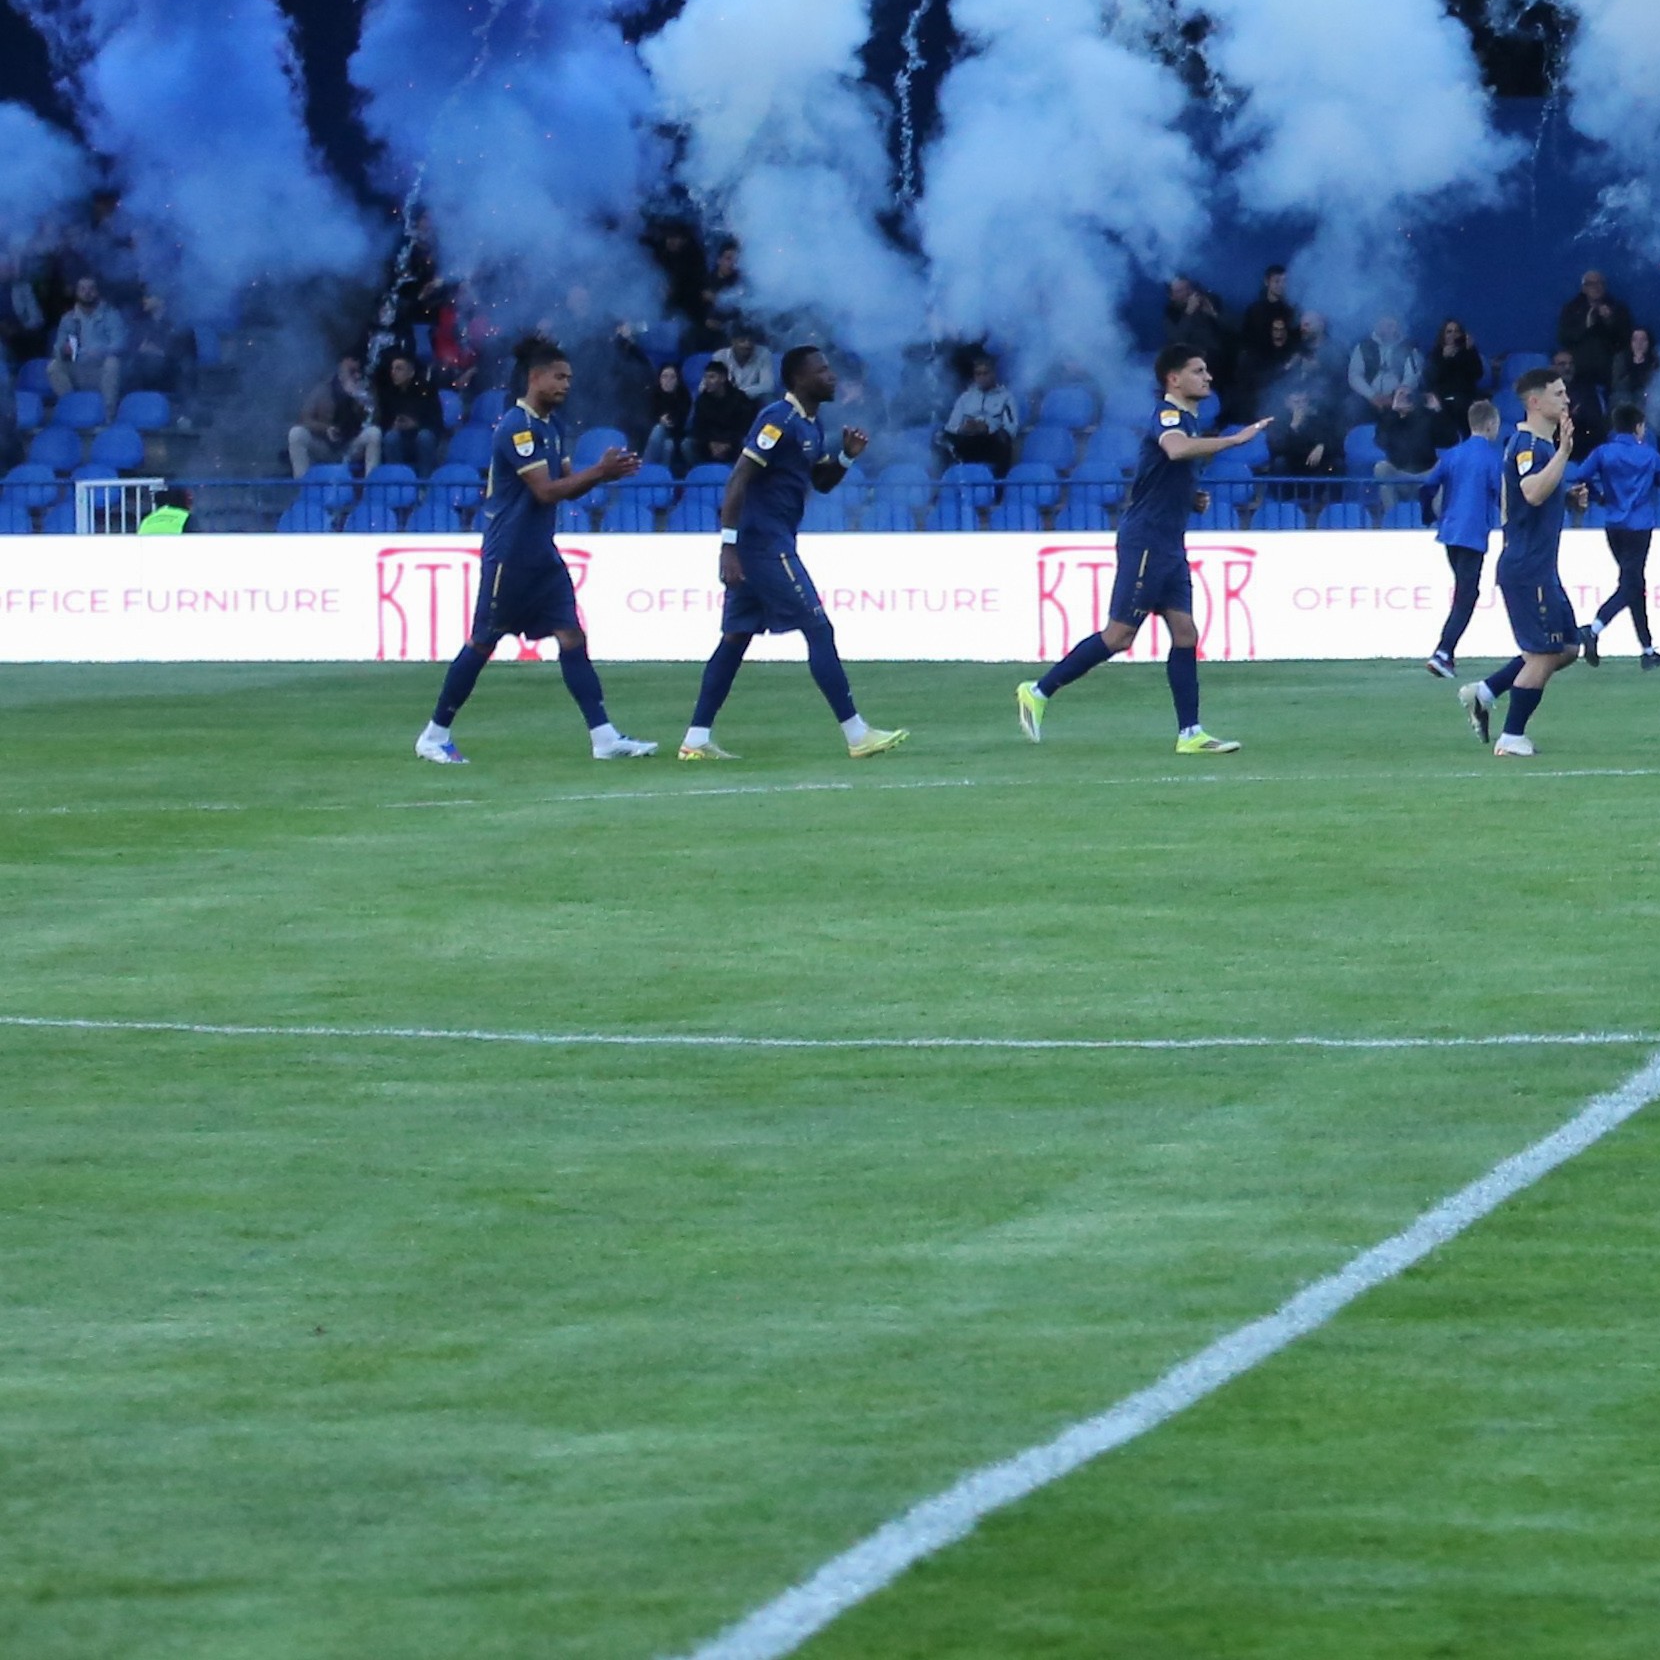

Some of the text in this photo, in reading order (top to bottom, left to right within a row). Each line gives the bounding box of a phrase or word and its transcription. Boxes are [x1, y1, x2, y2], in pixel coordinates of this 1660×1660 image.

[0, 588, 341, 613] FFICE FURNITURE
[820, 587, 1000, 612] RNITURE
[1293, 586, 1432, 610] OFFICE
